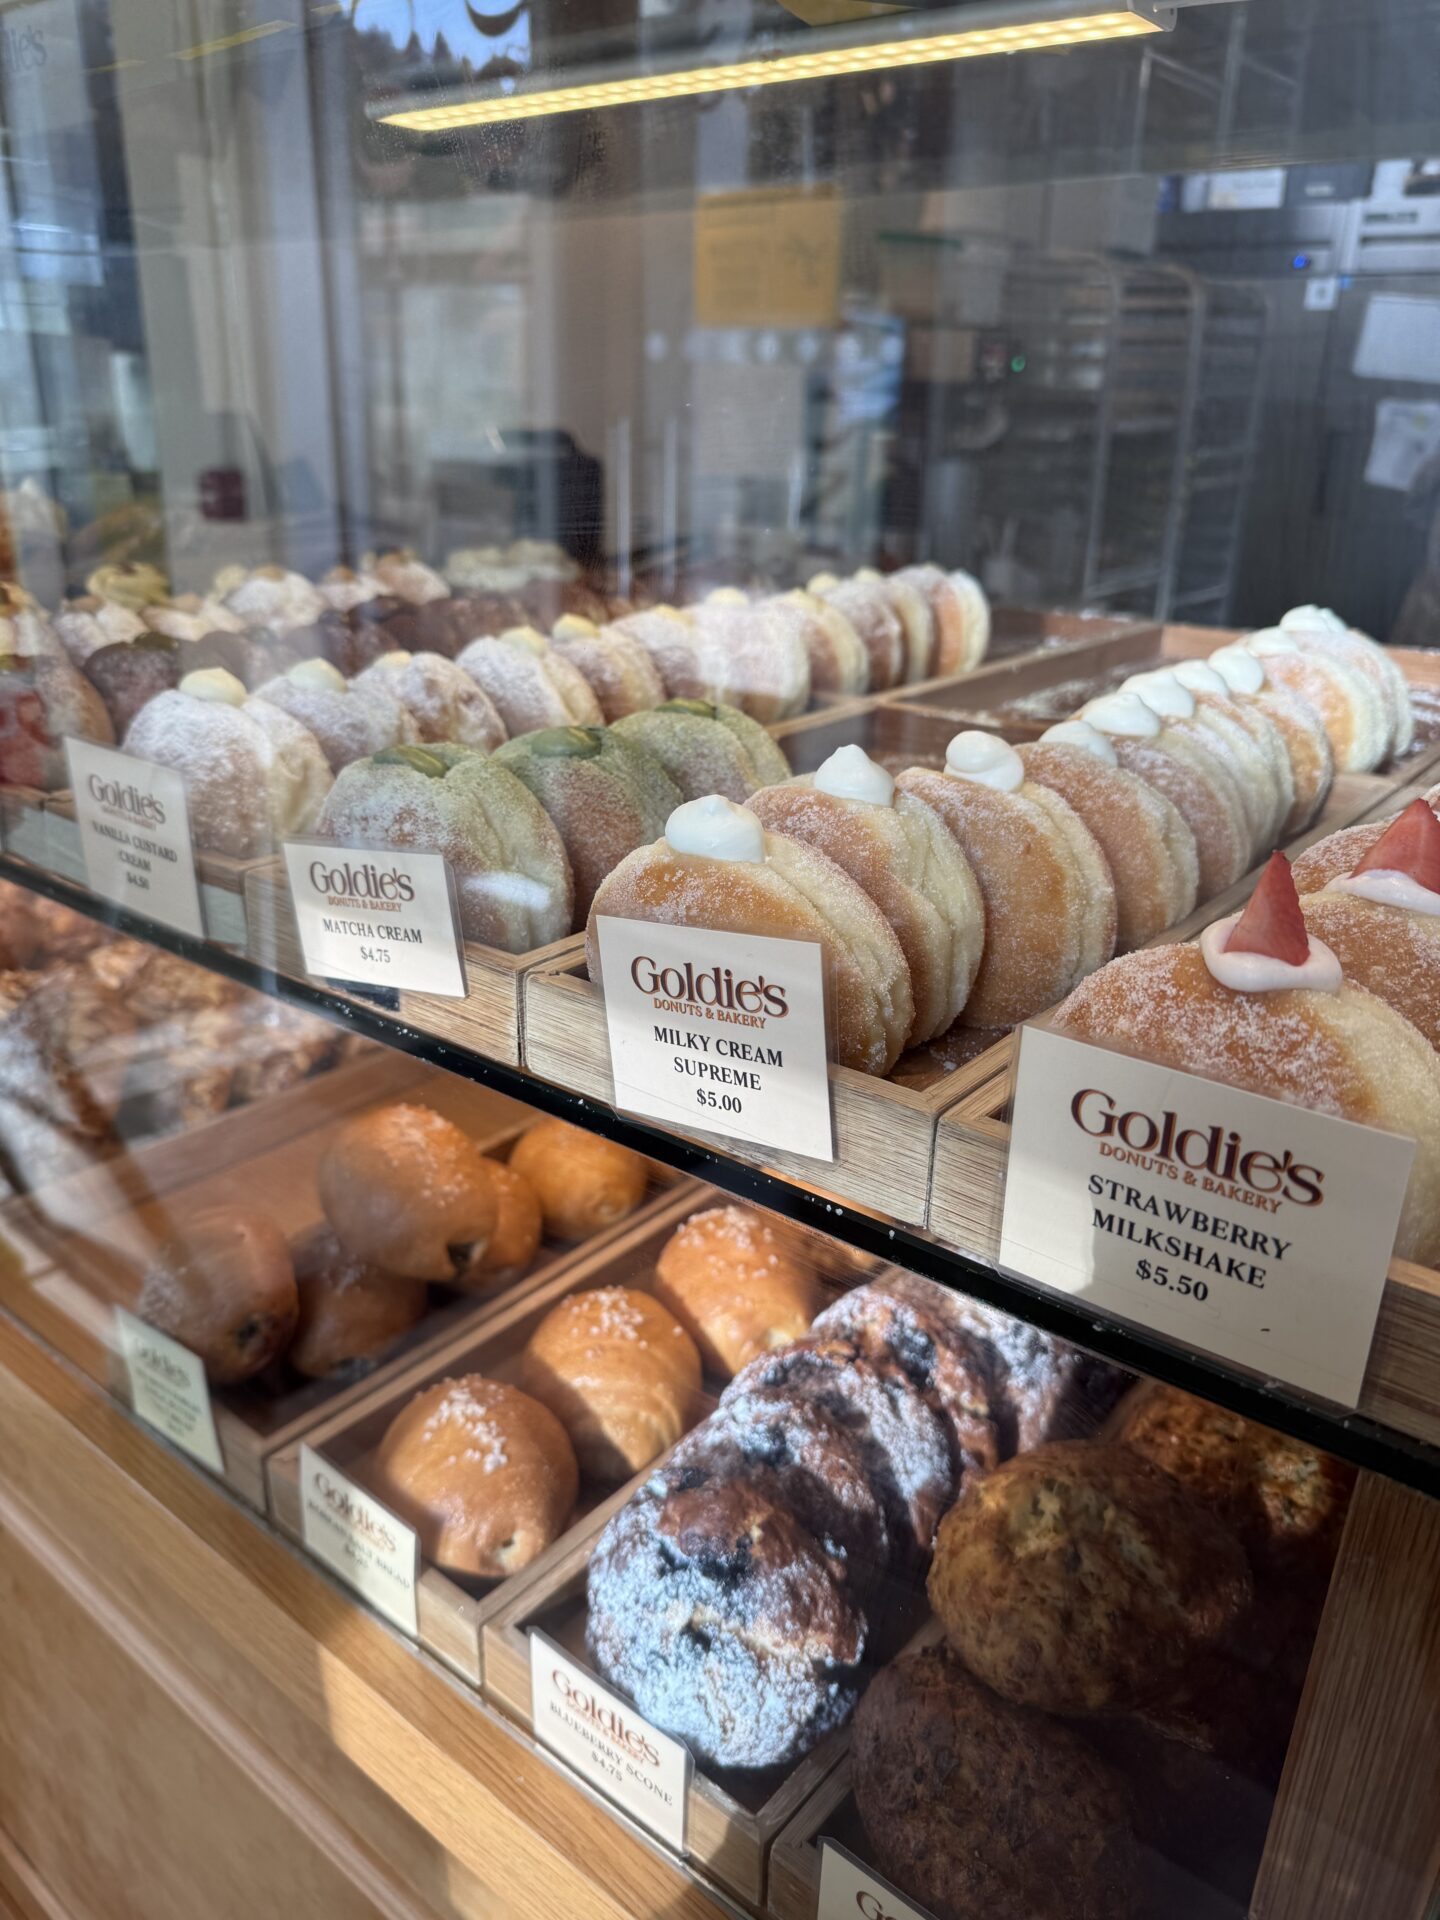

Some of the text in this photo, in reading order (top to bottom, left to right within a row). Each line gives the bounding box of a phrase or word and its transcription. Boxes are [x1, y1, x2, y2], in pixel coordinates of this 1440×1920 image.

[89, 773, 167, 825] Goldie's
[92, 820, 178, 863] VANILLA CUSTARD
[119, 849, 152, 872] CREAM
[310, 861, 416, 902] Goldie's
[327, 896, 402, 913] DONUTS & BAKERY
[322, 918, 423, 944] MATCHA CREAM
[360, 945, 391, 963] $4.75
[631, 956, 789, 1018] Goldie's
[653, 998, 767, 1029] DONUTS & BAKERY
[653, 1025, 784, 1068] MILKY CREAM
[674, 1056, 762, 1091] SUPREME
[696, 1087, 743, 1114] $5.00
[1071, 1088, 1325, 1208] Goldie's
[1099, 1141, 1283, 1215] DONUTS & BAKERY
[1088, 1174, 1292, 1261] STRAWBERRY
[1092, 1208, 1267, 1289] MILKSHAKE
[1135, 1258, 1209, 1302] $5.50
[552, 1669, 661, 1767] Goldie's
[550, 1700, 673, 1806] BLUEBERRY SCONE
[591, 1751, 623, 1782] $4.75
